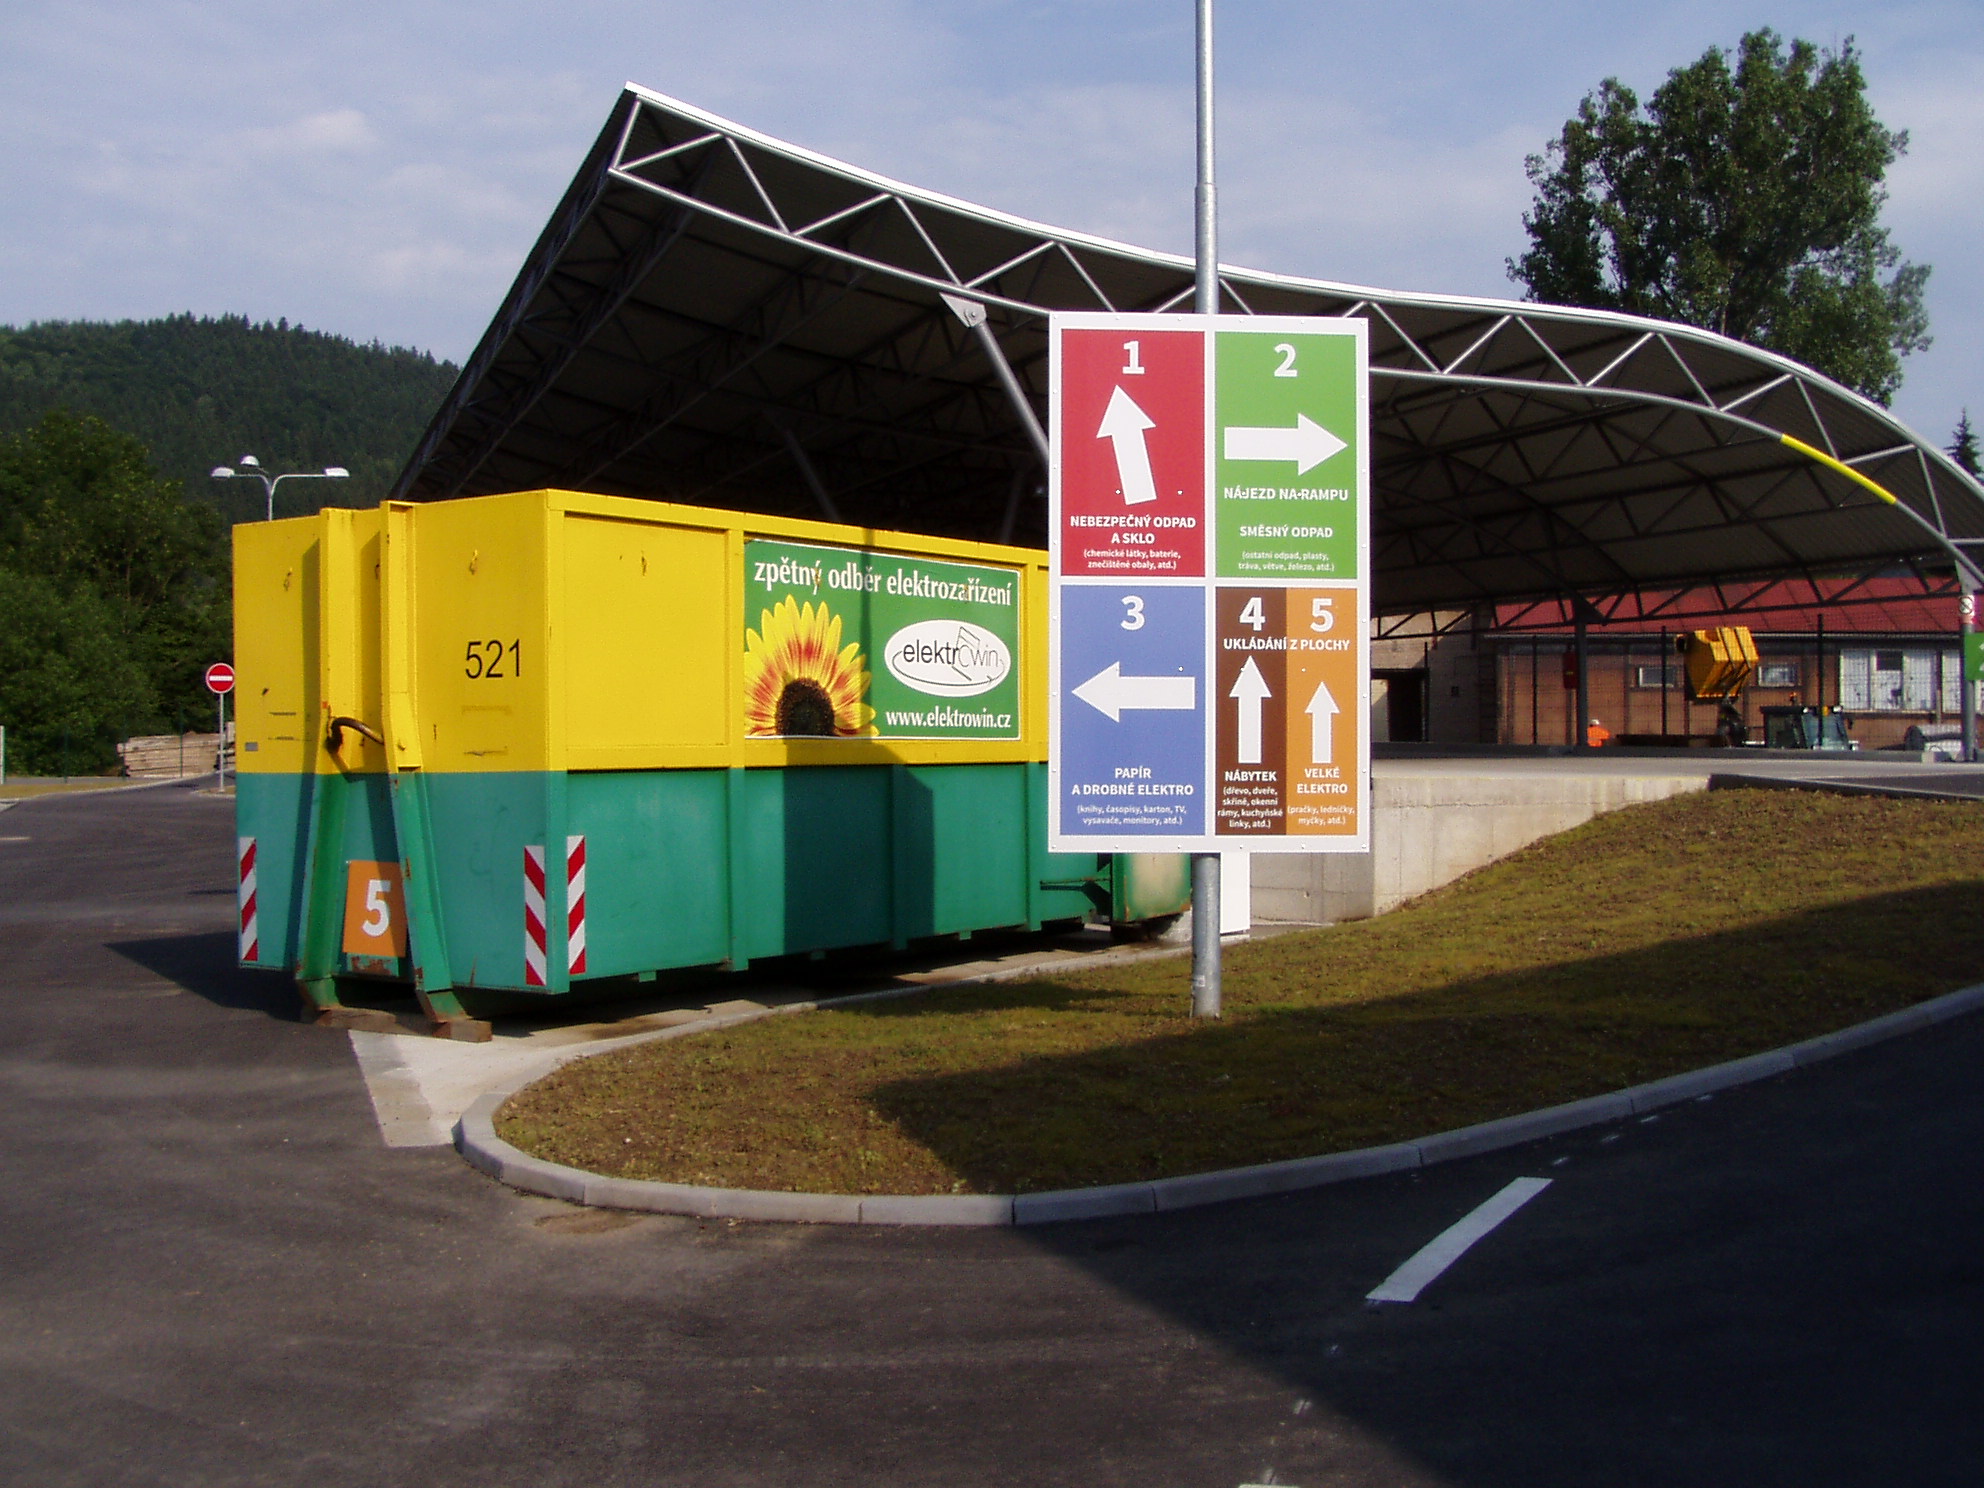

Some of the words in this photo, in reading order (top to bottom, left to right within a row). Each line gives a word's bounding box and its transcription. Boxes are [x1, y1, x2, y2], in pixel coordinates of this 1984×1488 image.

[1122, 340, 1145, 375] 1
[1273, 343, 1298, 377] 2
[1223, 485, 1276, 500] NÁJEZD
[1279, 488, 1298, 500] NA
[1300, 489, 1348, 501] RAMPU
[1070, 514, 1151, 528] NEBEZPEČNÝ
[1153, 517, 1196, 528] ODPAD
[1111, 532, 1120, 544] A
[1122, 532, 1155, 544] SKLO
[1240, 524, 1289, 537] SMĚSNÝ
[1291, 527, 1333, 538] ODPAD
[1083, 549, 1125, 559] (chemické
[1149, 549, 1181, 560] baterie,
[1131, 560, 1156, 570] obaly,
[1157, 560, 1177, 570] atd.)
[754, 556, 822, 595] zpětný
[828, 562, 882, 593] odběr
[886, 568, 1012, 606] elektrozařízení
[1120, 595, 1145, 630] 3
[1239, 597, 1266, 631] 4
[1310, 598, 1334, 633] 5
[1223, 636, 1287, 650] UKLÁDÁNÍ
[1289, 639, 1298, 650] Z
[1300, 639, 1350, 651] PLOCHY
[465, 638, 520, 679] 521
[886, 705, 1011, 728] www.elektrowin.cz
[1114, 765, 1152, 779] PAPÍR
[1224, 769, 1277, 782] NÁBYTEK
[1304, 767, 1340, 779] VELKÉ
[1071, 784, 1081, 796] A
[1083, 782, 1135, 796] DROBNÉ
[1137, 784, 1194, 796] ELEKTRO
[1296, 783, 1348, 795] ELEKTRO
[1077, 804, 1104, 815] (knihy,
[1105, 804, 1142, 815] časopisy,
[1143, 804, 1173, 815] karton,
[1123, 815, 1162, 826] monitory,
[1163, 815, 1183, 826] atd.)
[1252, 819, 1271, 829] atd.)
[361, 880, 391, 937] 5
